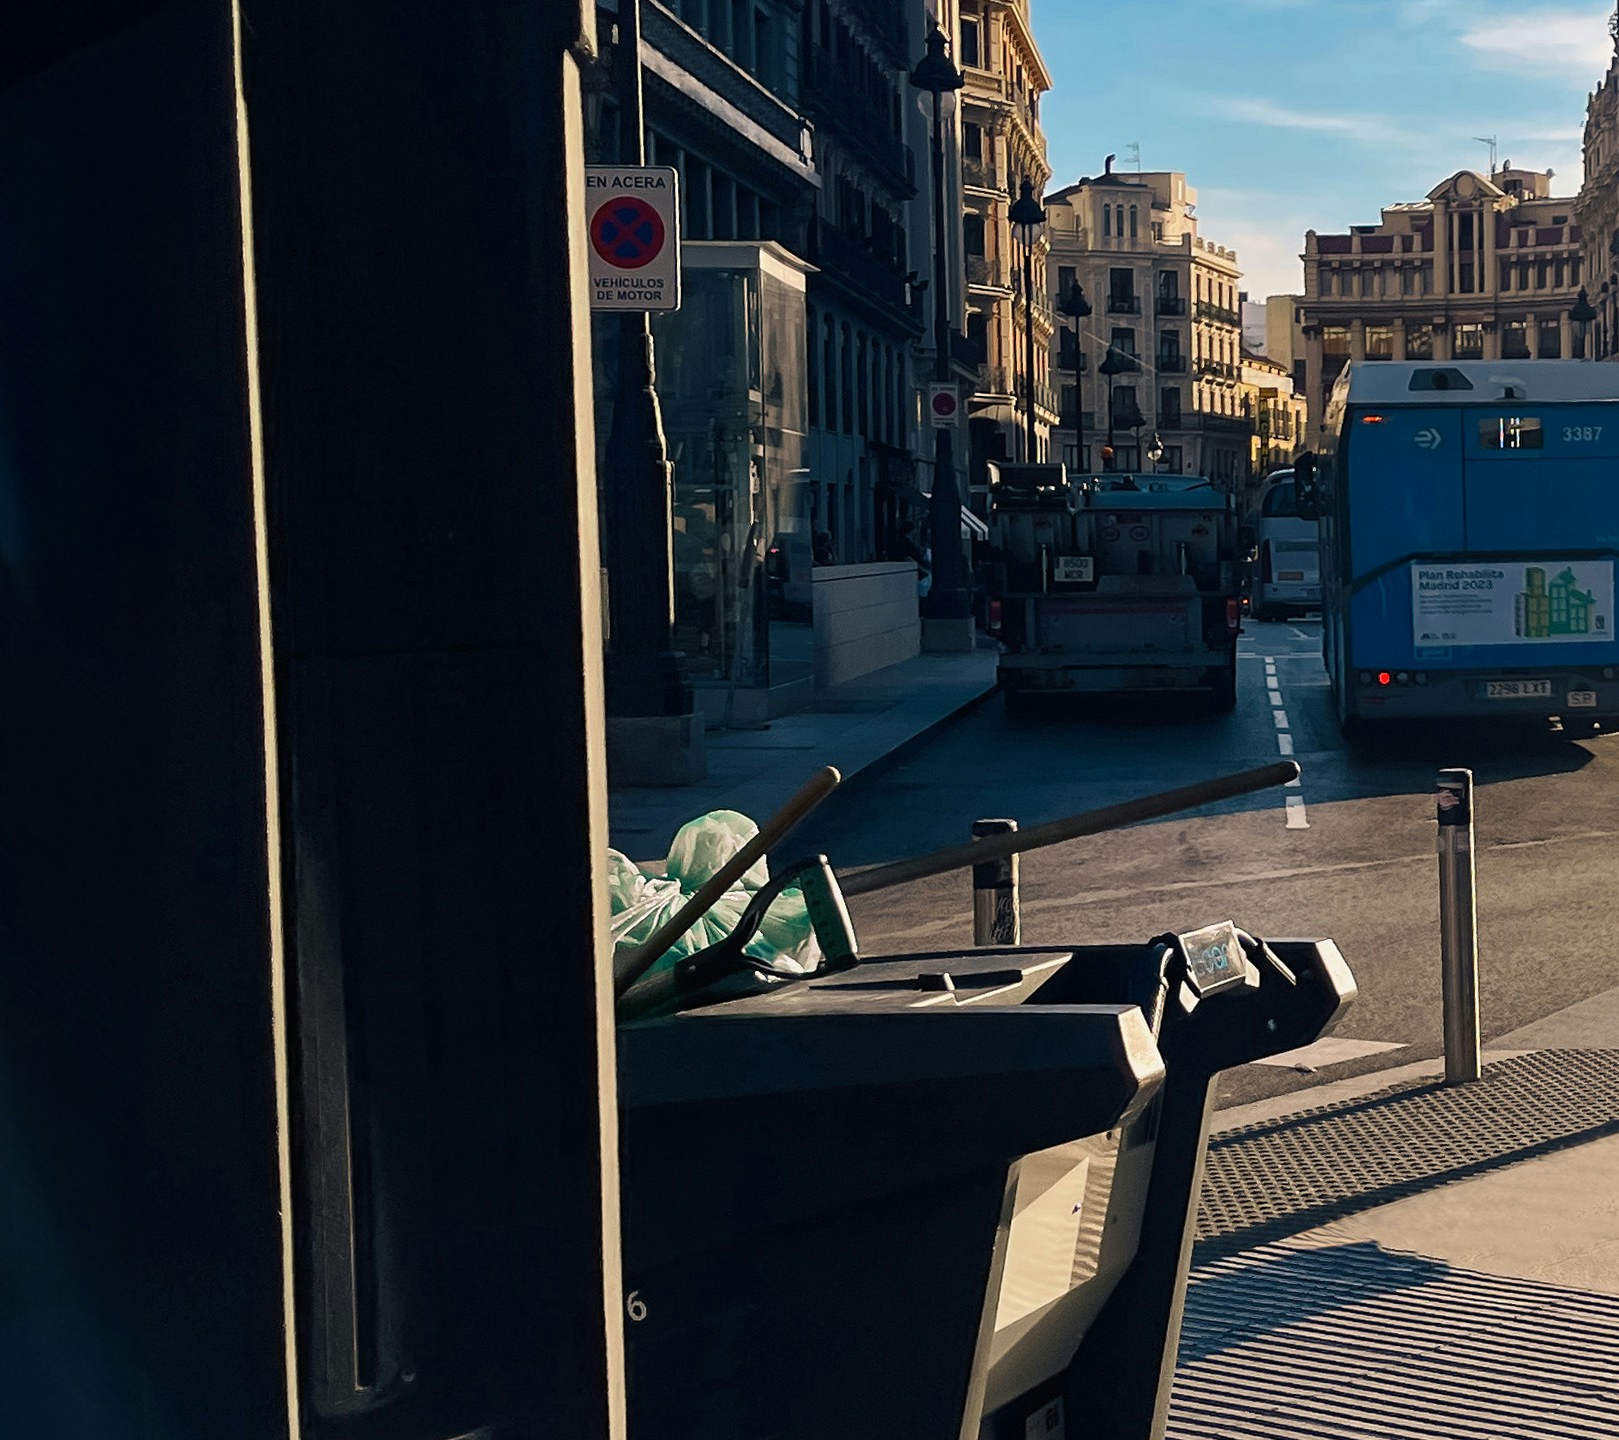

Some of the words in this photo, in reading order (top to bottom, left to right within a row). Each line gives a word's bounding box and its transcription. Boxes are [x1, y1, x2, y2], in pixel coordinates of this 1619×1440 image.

[586, 176, 607, 189] EN
[611, 176, 666, 189] ACERA
[593, 276, 665, 289] VEHÍCULOS
[596, 290, 613, 301] DE
[617, 290, 663, 301] MOTOR
[1562, 426, 1603, 442] 3387
[1418, 570, 1444, 580] Plan
[1446, 569, 1505, 580] Rehabilita
[1418, 581, 1460, 591] Madrid
[1461, 580, 1494, 590] 2023
[626, 1289, 648, 1322] 6
